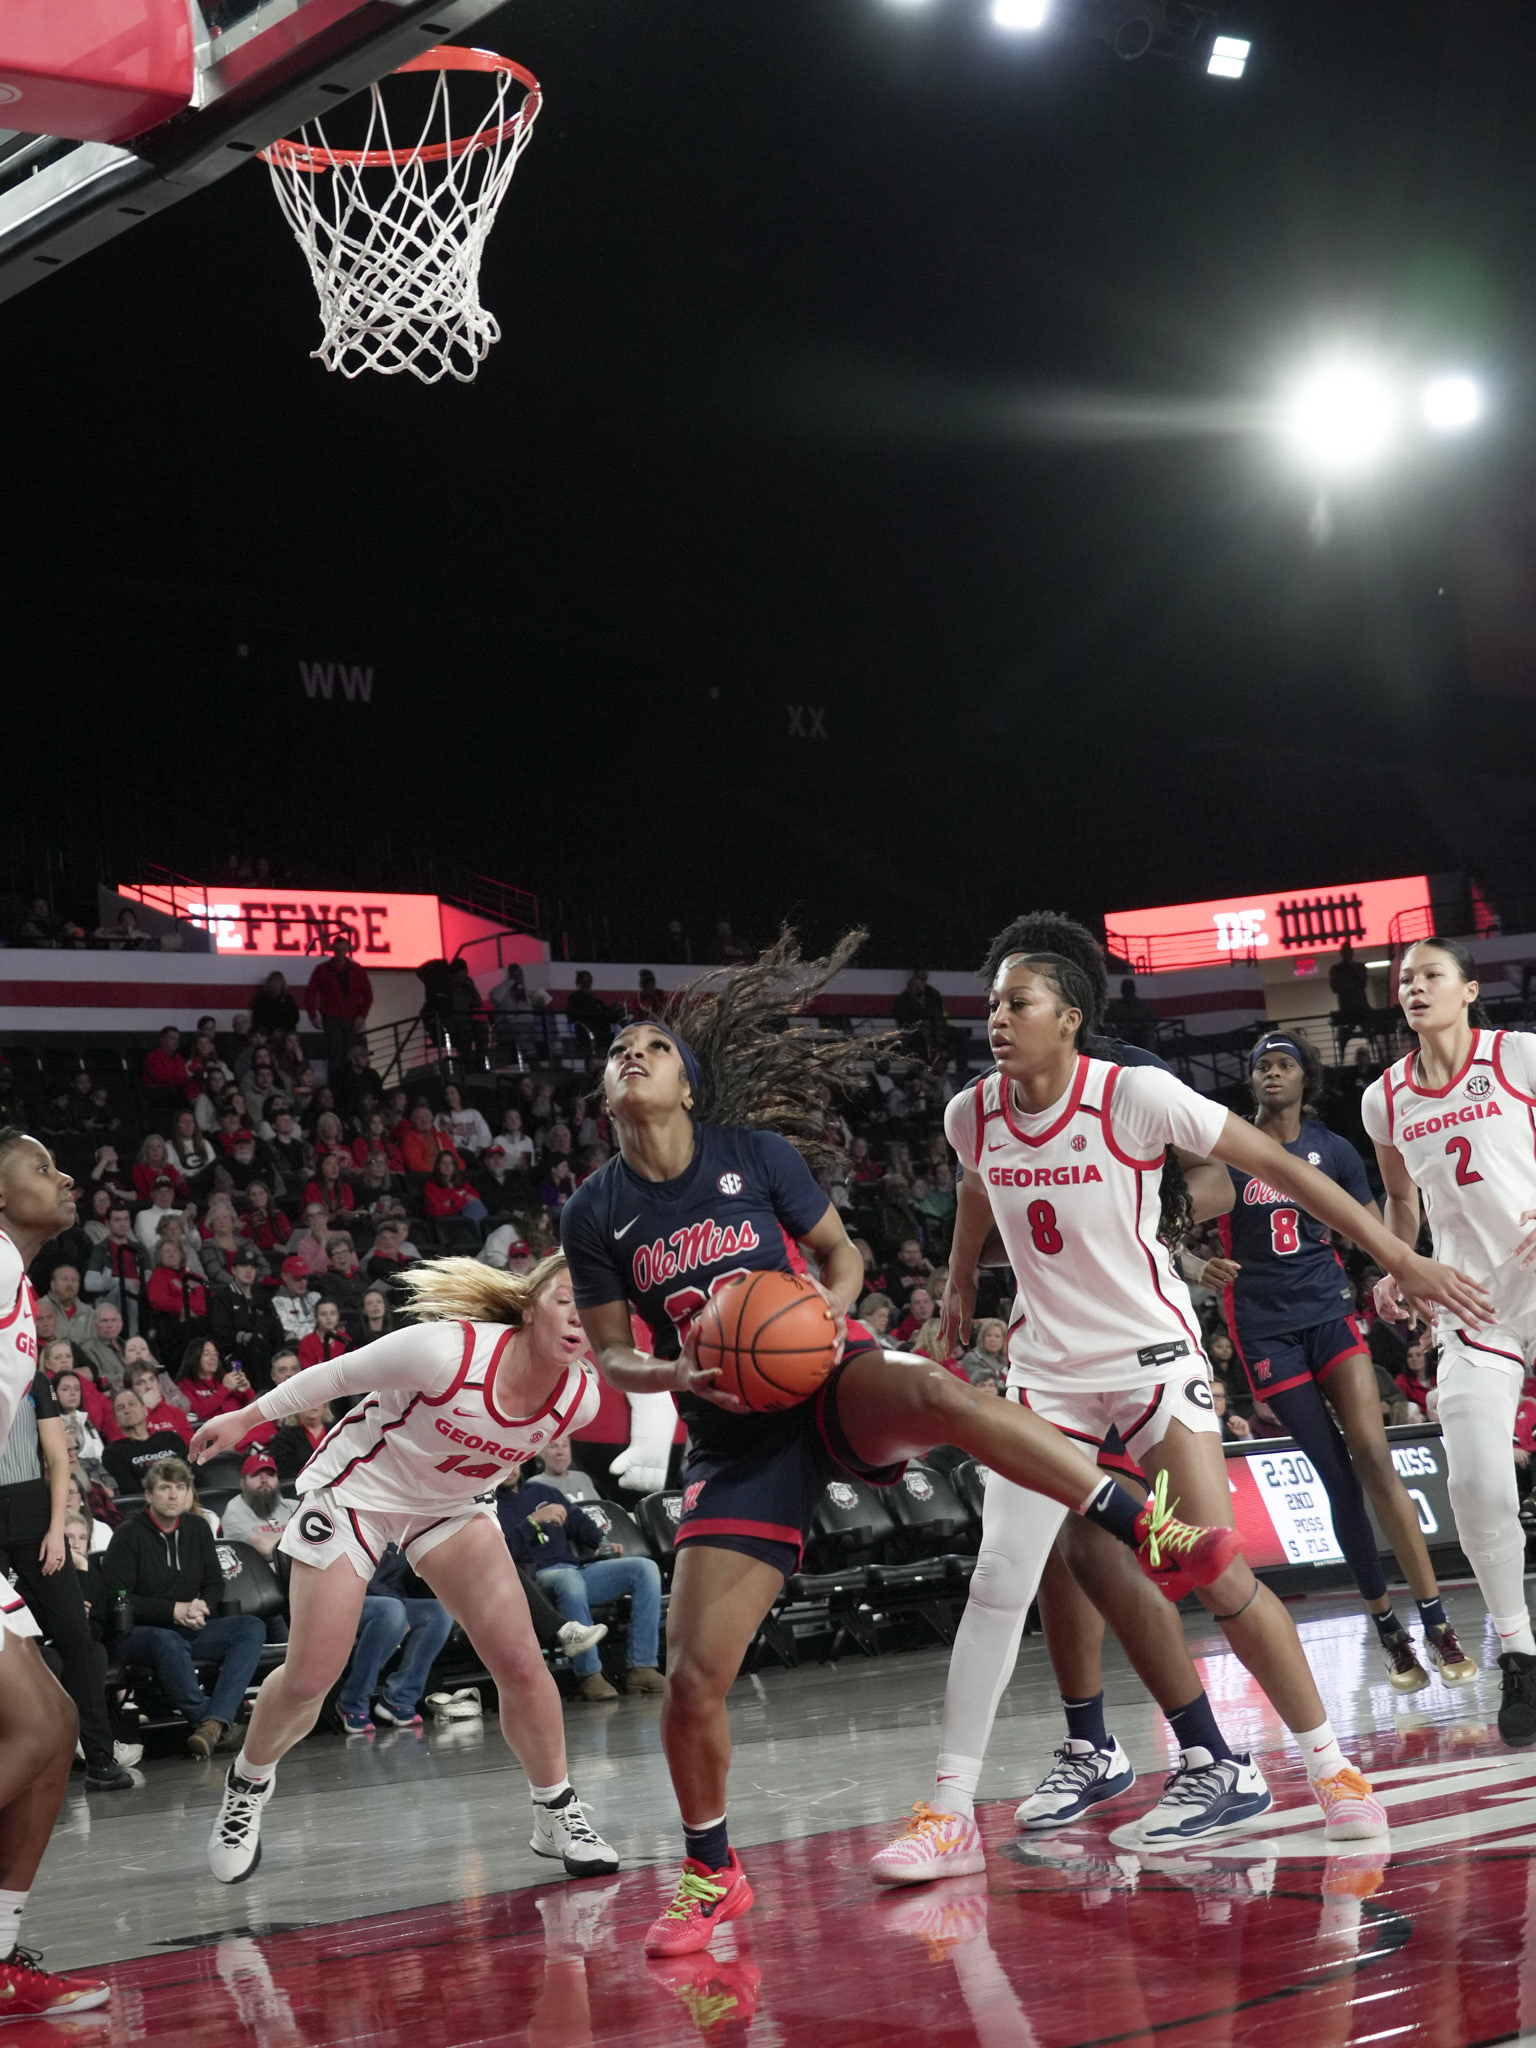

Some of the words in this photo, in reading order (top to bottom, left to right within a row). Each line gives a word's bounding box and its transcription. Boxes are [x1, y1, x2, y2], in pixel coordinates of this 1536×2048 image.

[299, 661, 374, 701] WW
[785, 703, 828, 739] XX
[1213, 909, 1268, 950] DE
[1469, 1077, 1489, 1094] SEC
[1403, 1101, 1502, 1142] GEORGIA
[1072, 1135, 1087, 1152] SEC
[988, 1164, 1103, 1187] GEORGIA
[1445, 1136, 1484, 1186] 2
[719, 1172, 742, 1195] SEC
[1027, 1199, 1063, 1255] 8
[1270, 1208, 1300, 1255] 8
[633, 1238, 677, 1292] Ole
[669, 1218, 760, 1274] Miss
[1184, 1379, 1213, 1410] G
[132, 1450, 176, 1464] GEORGIA
[434, 1455, 502, 1479] 14
[1262, 1457, 1314, 1487] 2:30
[1285, 1492, 1314, 1510] 2ND
[300, 1511, 333, 1542] G
[1294, 1517, 1324, 1533] POSS
[1289, 1541, 1300, 1557] 5
[1306, 1538, 1329, 1553] FLS
